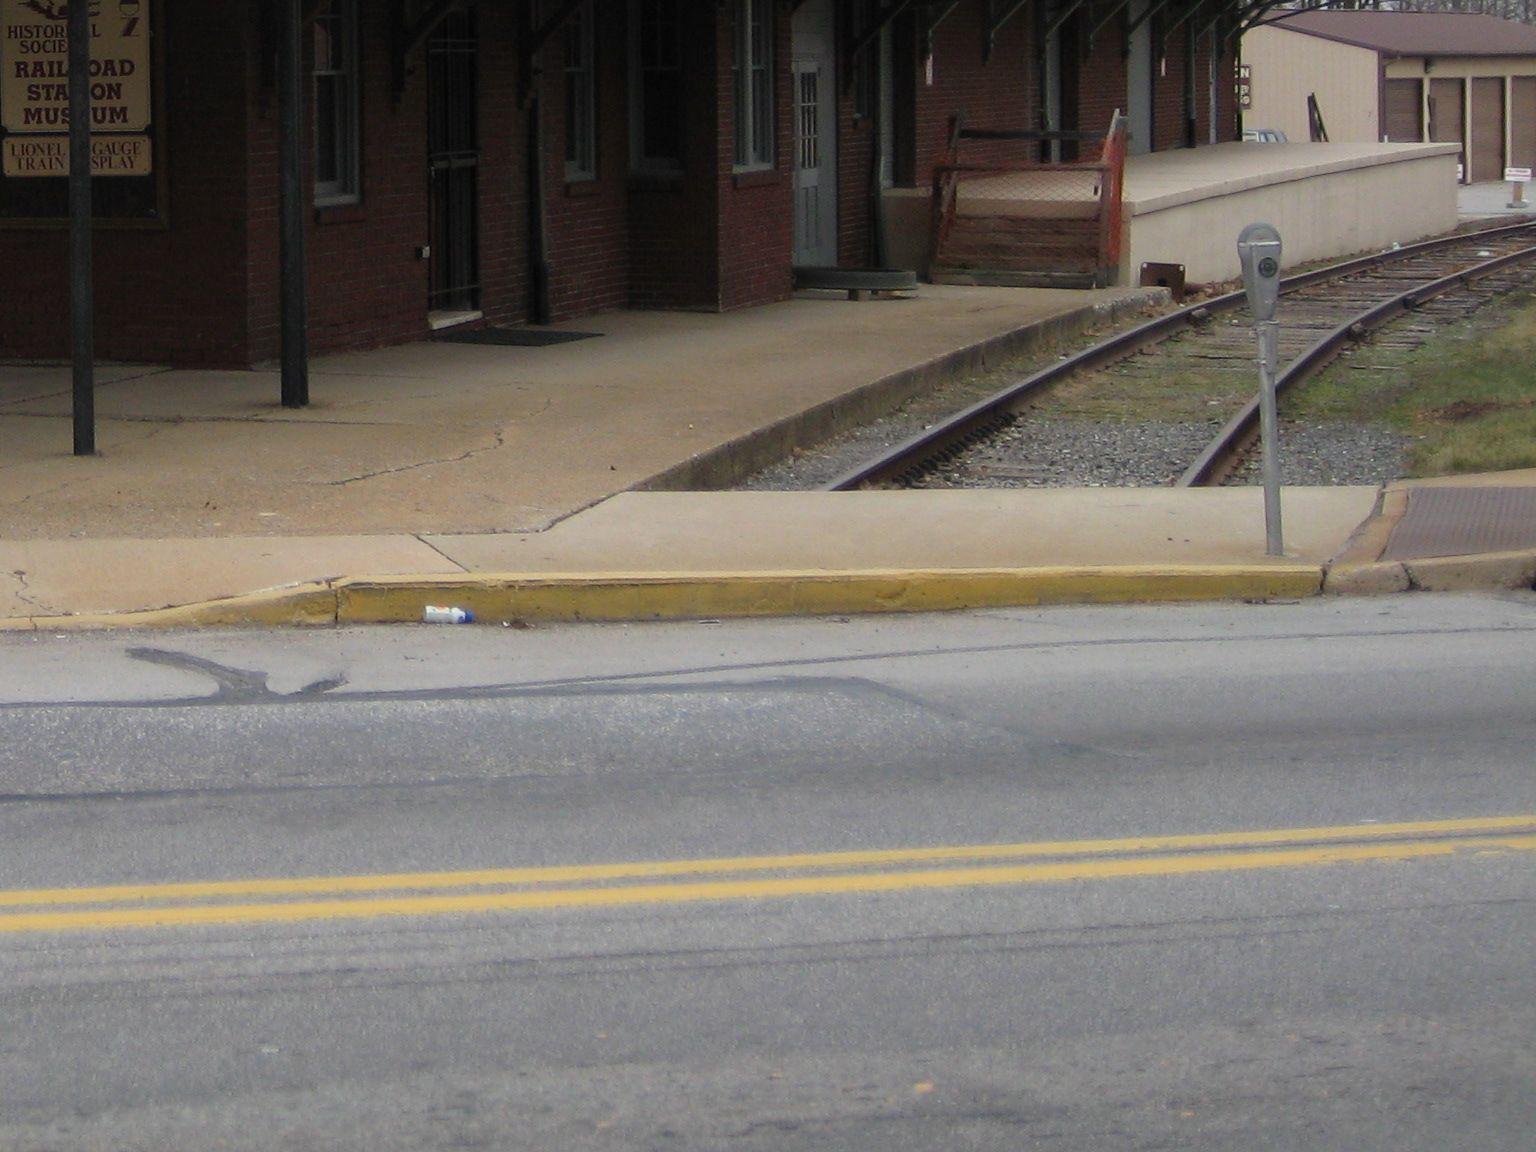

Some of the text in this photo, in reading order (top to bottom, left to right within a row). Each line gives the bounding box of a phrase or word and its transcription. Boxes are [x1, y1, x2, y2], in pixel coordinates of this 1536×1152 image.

[19, 39, 68, 54] SOCIE
[14, 59, 135, 78] RAILOAD
[27, 83, 122, 101] STAON
[23, 106, 128, 125] MUSUM
[11, 141, 141, 156] LIONEL GAUGE
[17, 156, 136, 170] TRAIN SPLAY
